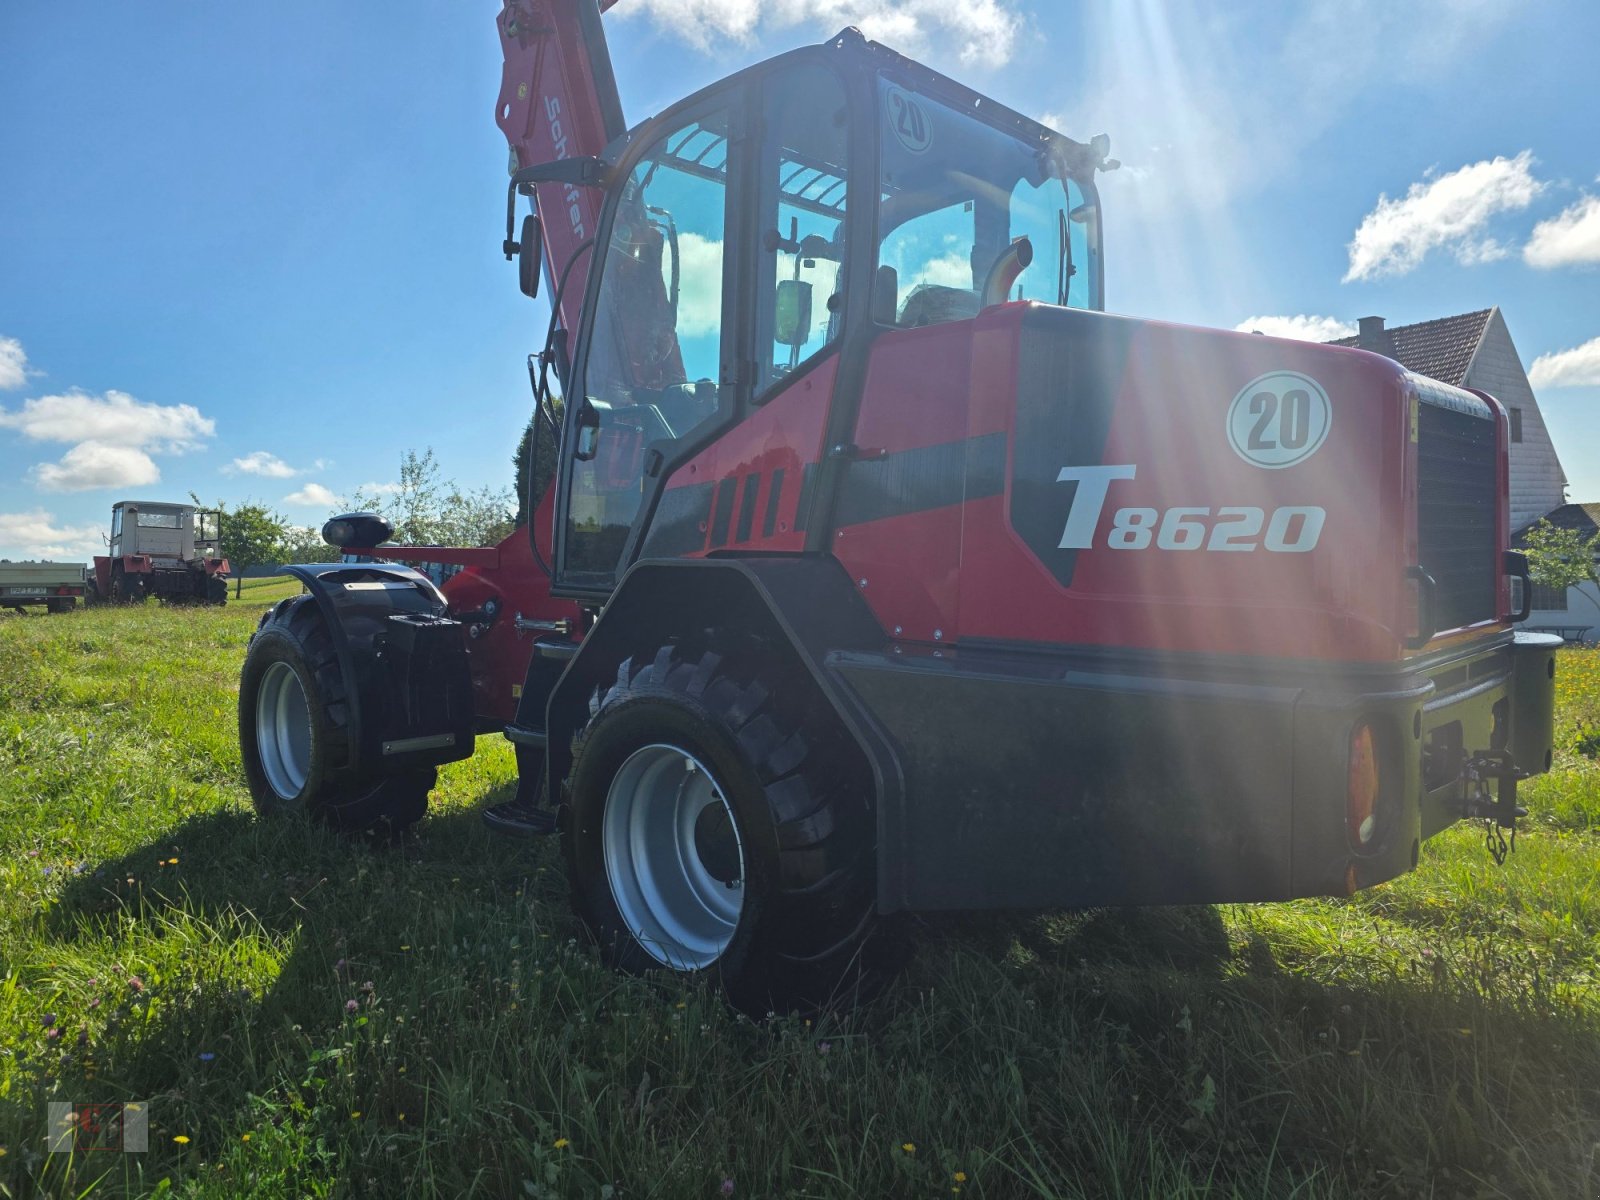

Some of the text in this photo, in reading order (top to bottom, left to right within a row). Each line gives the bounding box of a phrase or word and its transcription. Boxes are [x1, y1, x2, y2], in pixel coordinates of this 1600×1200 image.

[893, 93, 925, 142] 20
[543, 95, 585, 240] Schfer
[1247, 389, 1311, 451] 20
[1055, 464, 1326, 553] T8620
